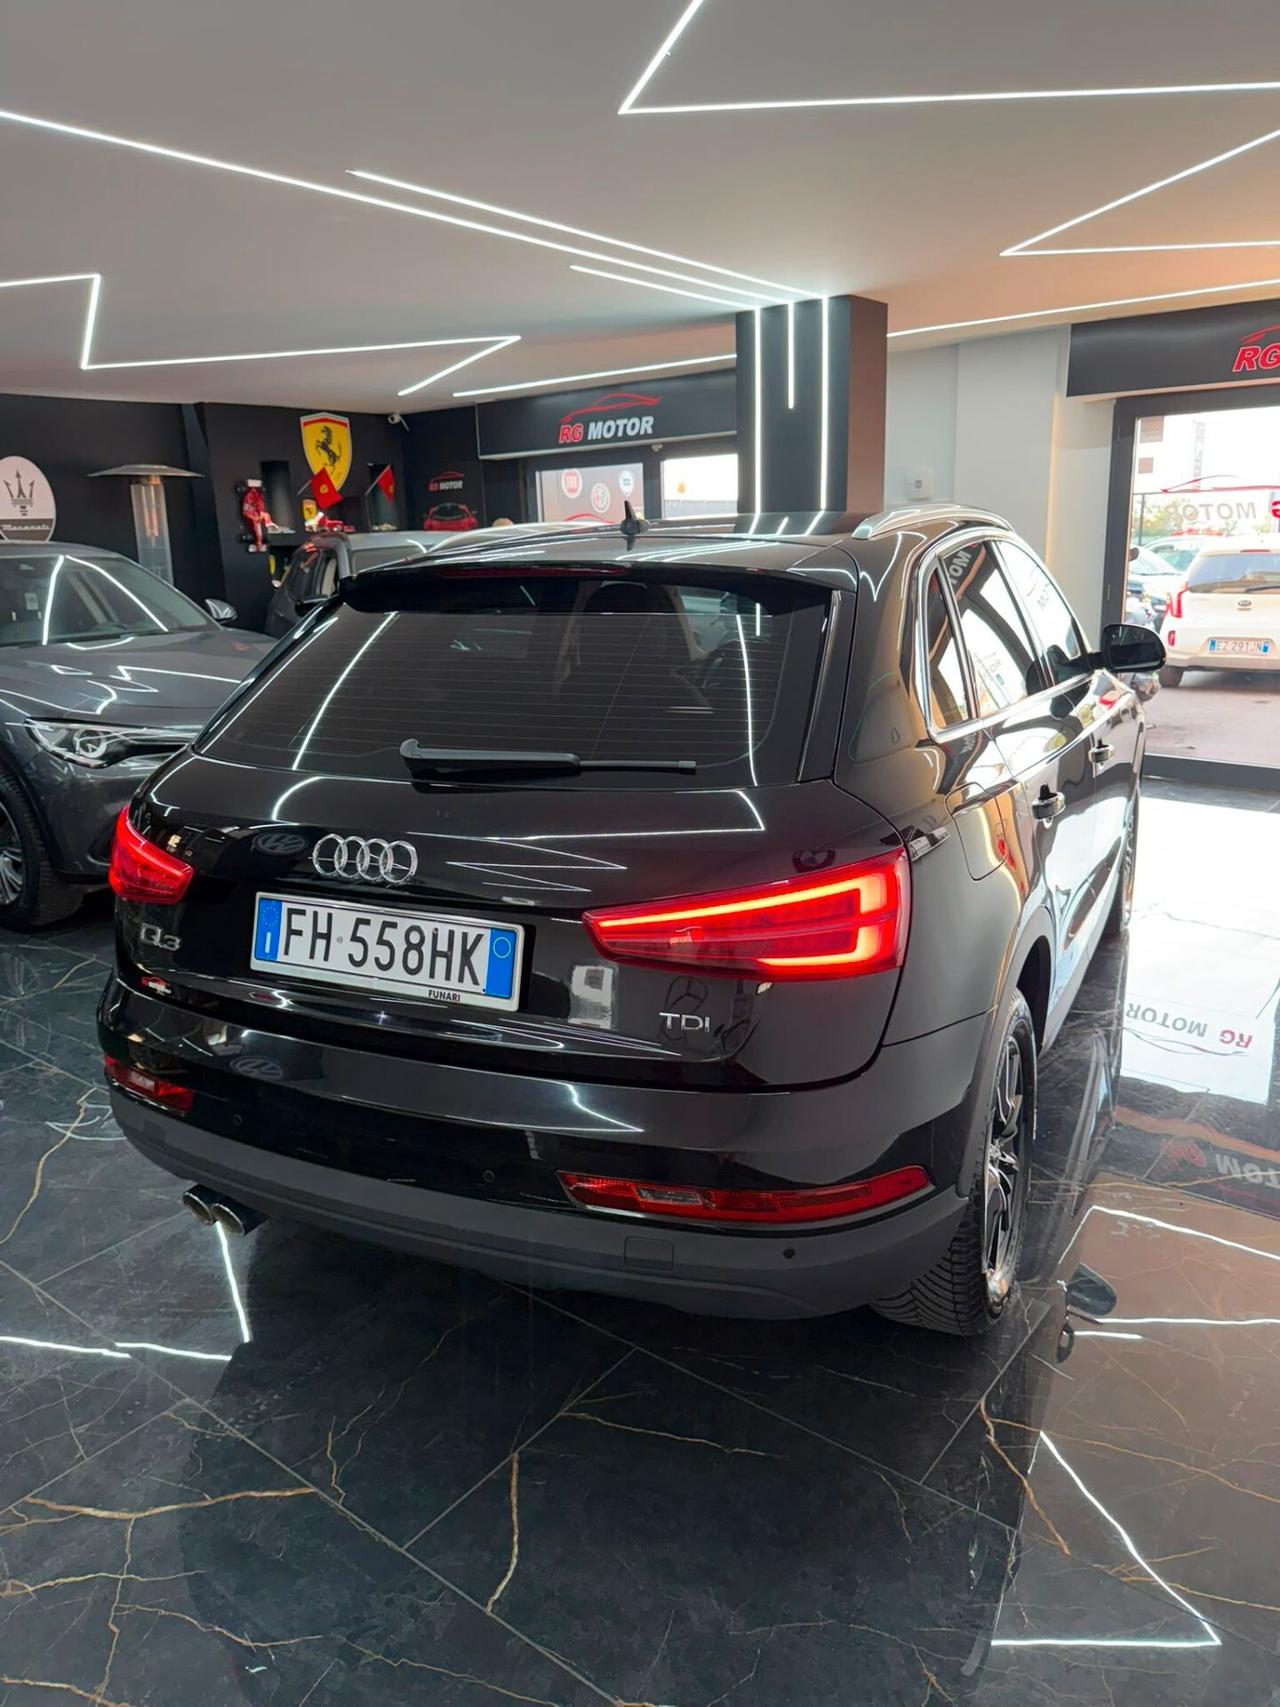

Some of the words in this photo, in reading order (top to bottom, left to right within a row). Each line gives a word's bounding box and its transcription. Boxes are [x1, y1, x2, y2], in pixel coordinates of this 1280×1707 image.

[1232, 343, 1280, 372] RG
[559, 423, 584, 444] RG
[587, 416, 654, 440] MOTOR
[141, 923, 180, 951] Q3
[284, 908, 333, 962] FH
[348, 916, 484, 986] 558HK
[428, 989, 461, 1002] FUNARI
[659, 1012, 710, 1032] TDI
[1126, 1003, 1208, 1038] MOTOR
